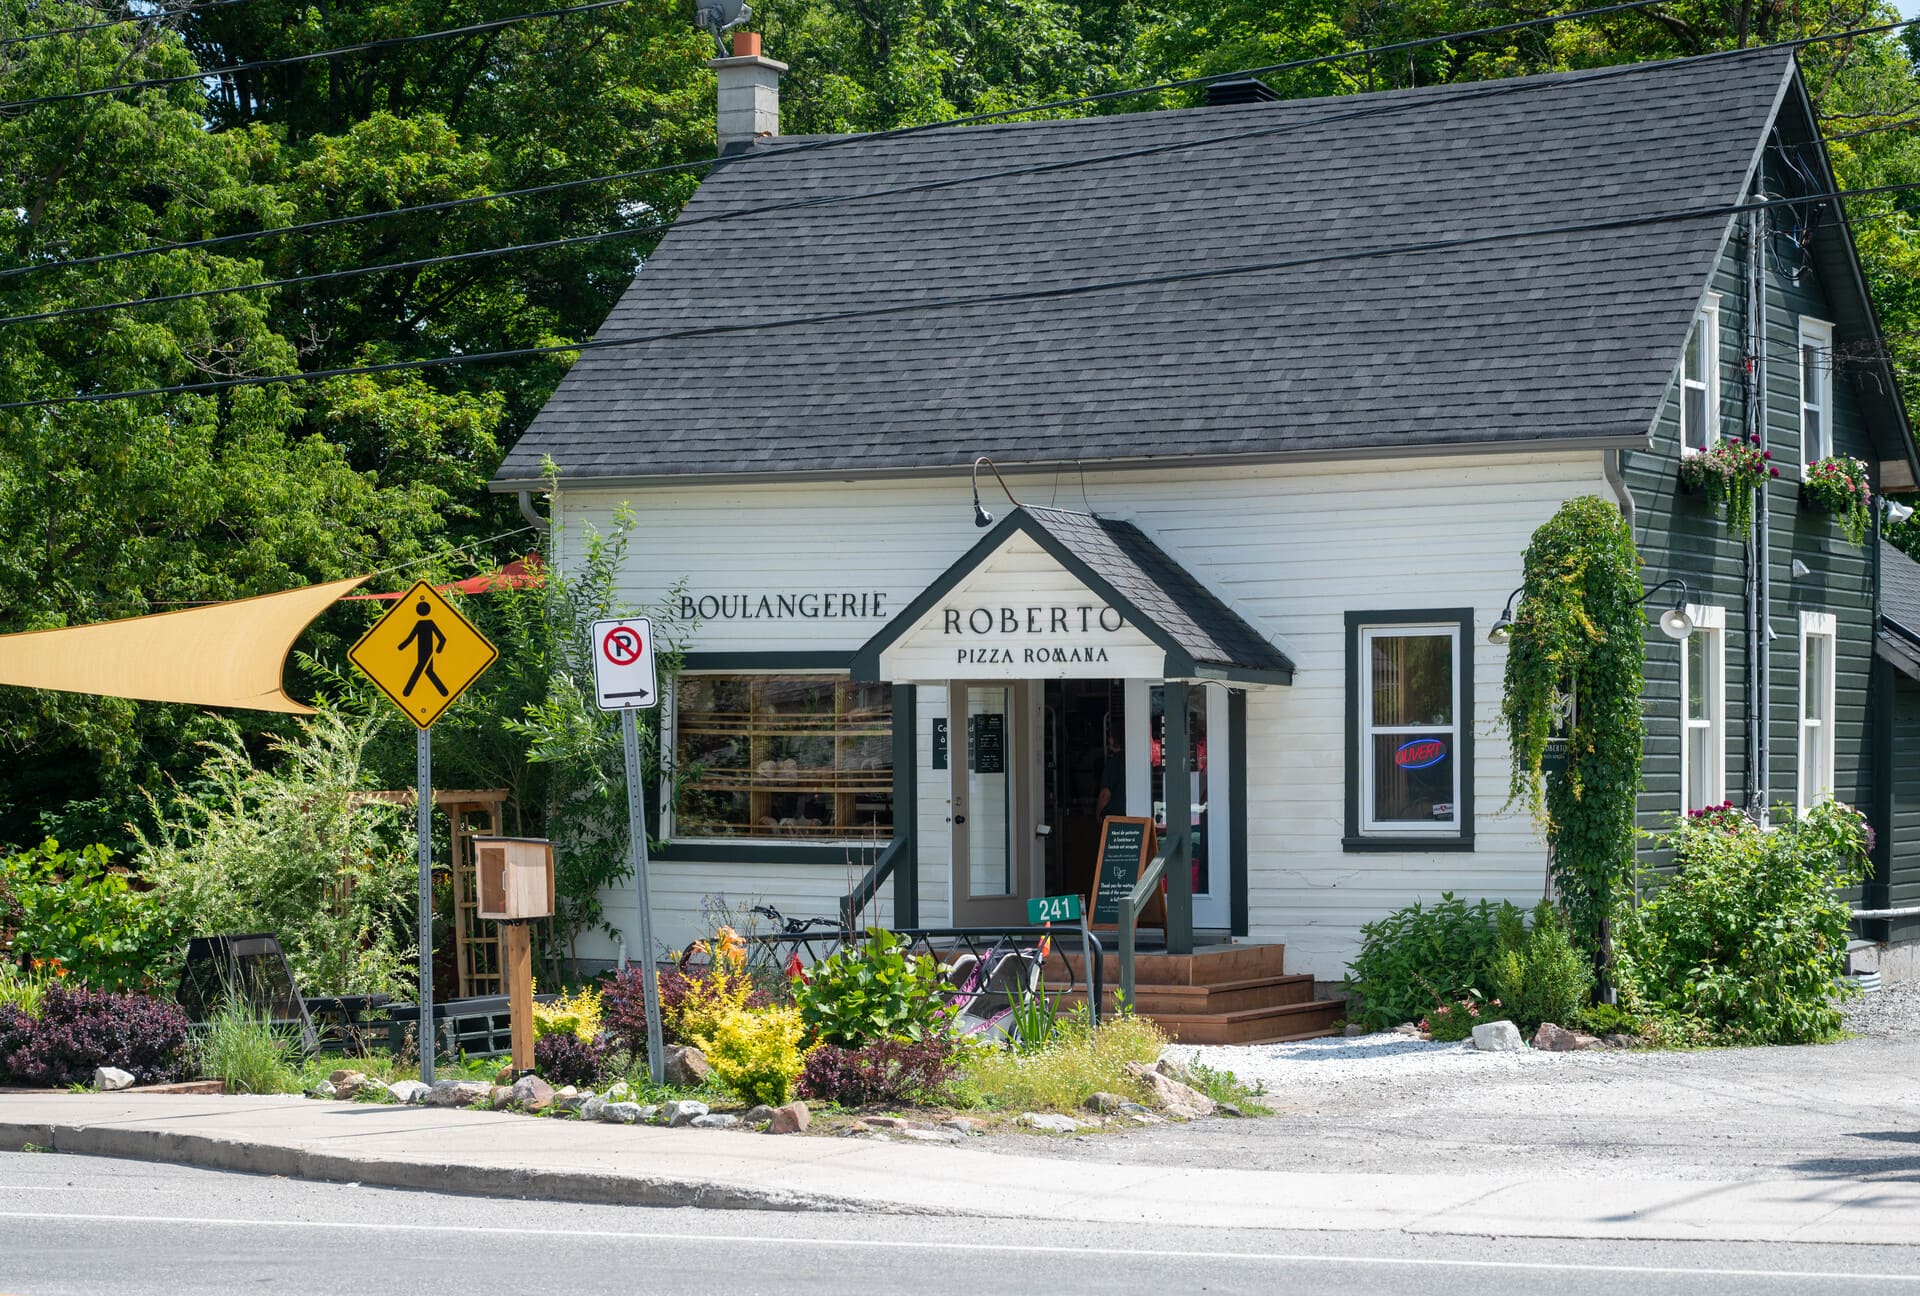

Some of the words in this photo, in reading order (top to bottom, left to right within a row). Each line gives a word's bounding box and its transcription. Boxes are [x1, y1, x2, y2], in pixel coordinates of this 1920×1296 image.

[680, 593, 887, 620] BOULANGERIE
[944, 606, 1124, 635] ROBERTO
[957, 648, 1014, 664] PIZZA
[1024, 647, 1109, 663] ROMANA
[1395, 742, 1442, 766] OUVERT
[1039, 898, 1070, 921] 241
